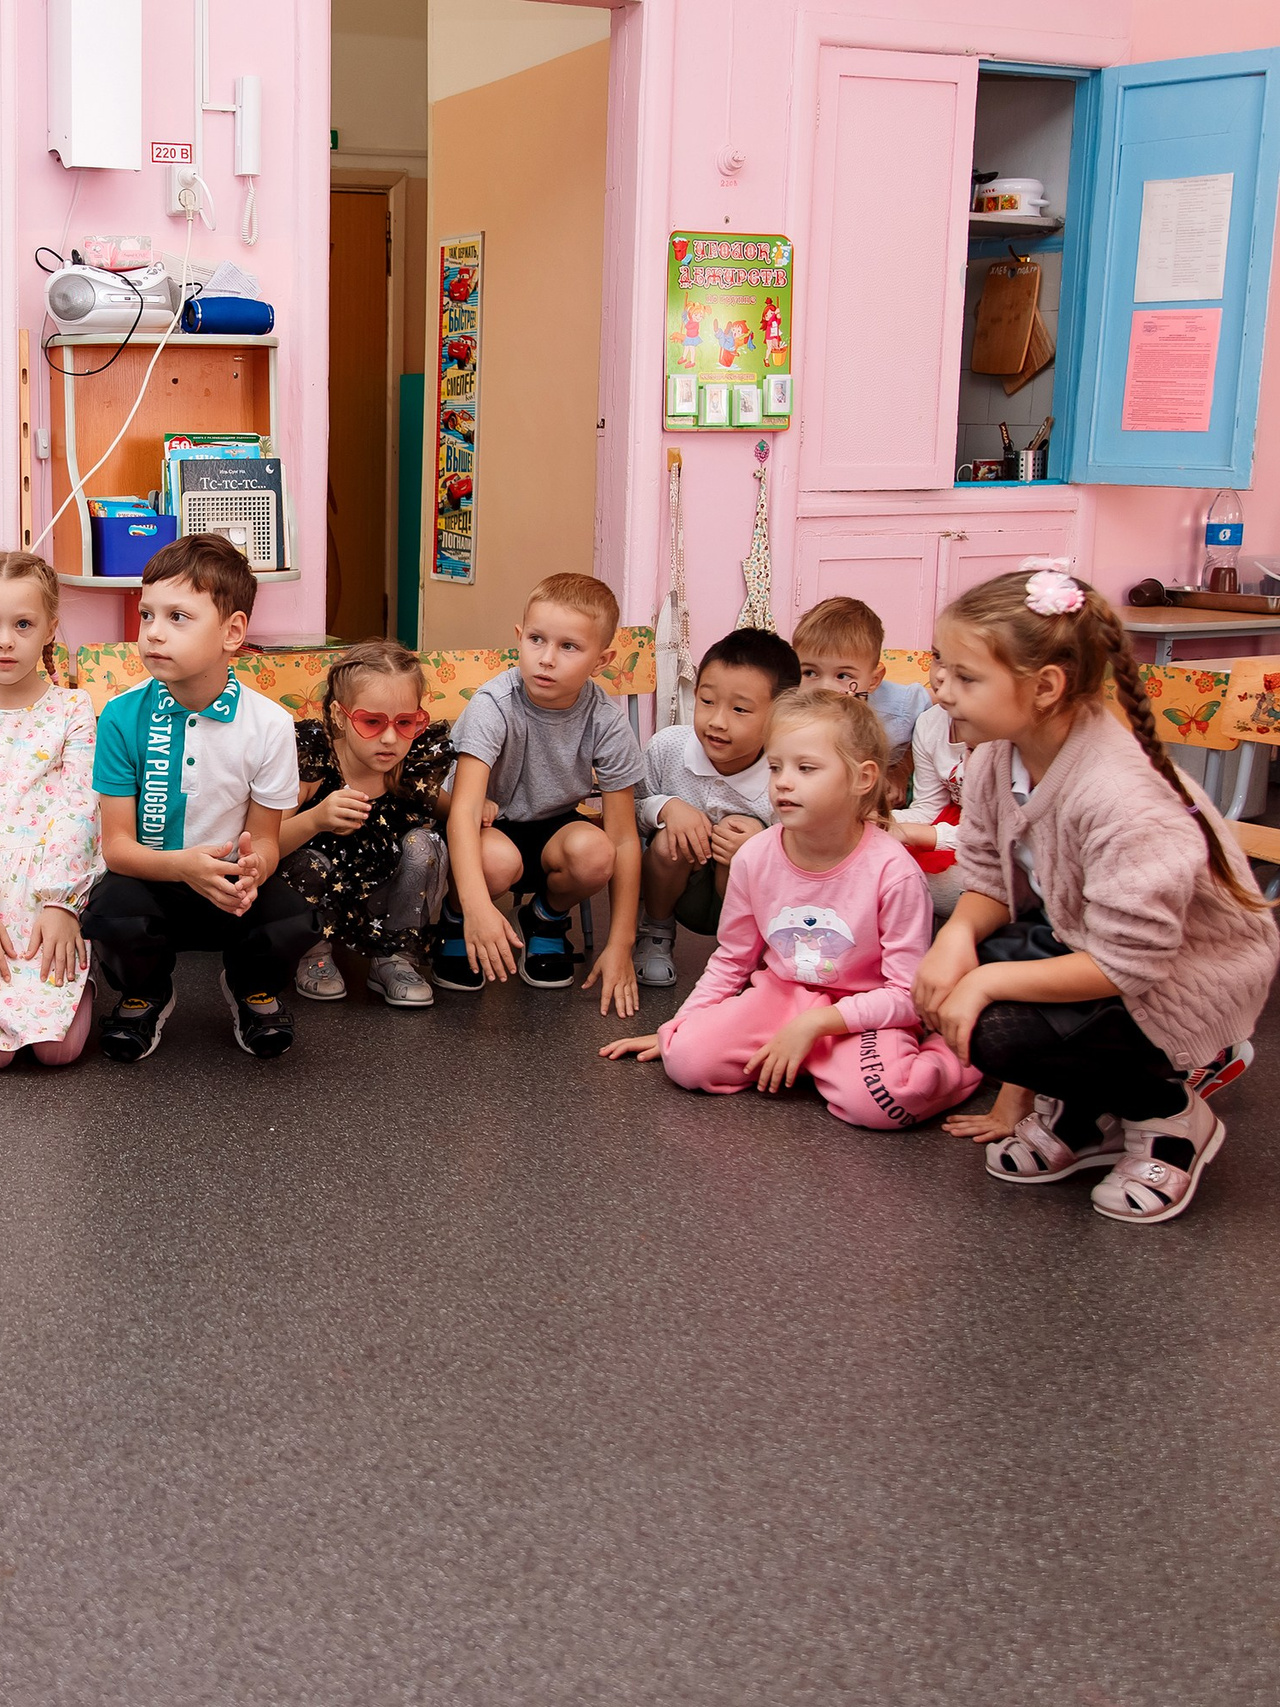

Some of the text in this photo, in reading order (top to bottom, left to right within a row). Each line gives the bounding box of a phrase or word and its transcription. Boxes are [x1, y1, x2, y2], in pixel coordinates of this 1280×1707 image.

[154, 147, 177, 159] 220
[693, 239, 772, 264] УГОЛОК
[678, 265, 788, 290] ДЕЖУРСТВ
[147, 712, 172, 756] STAY
[142, 759, 170, 833] PLUGGED
